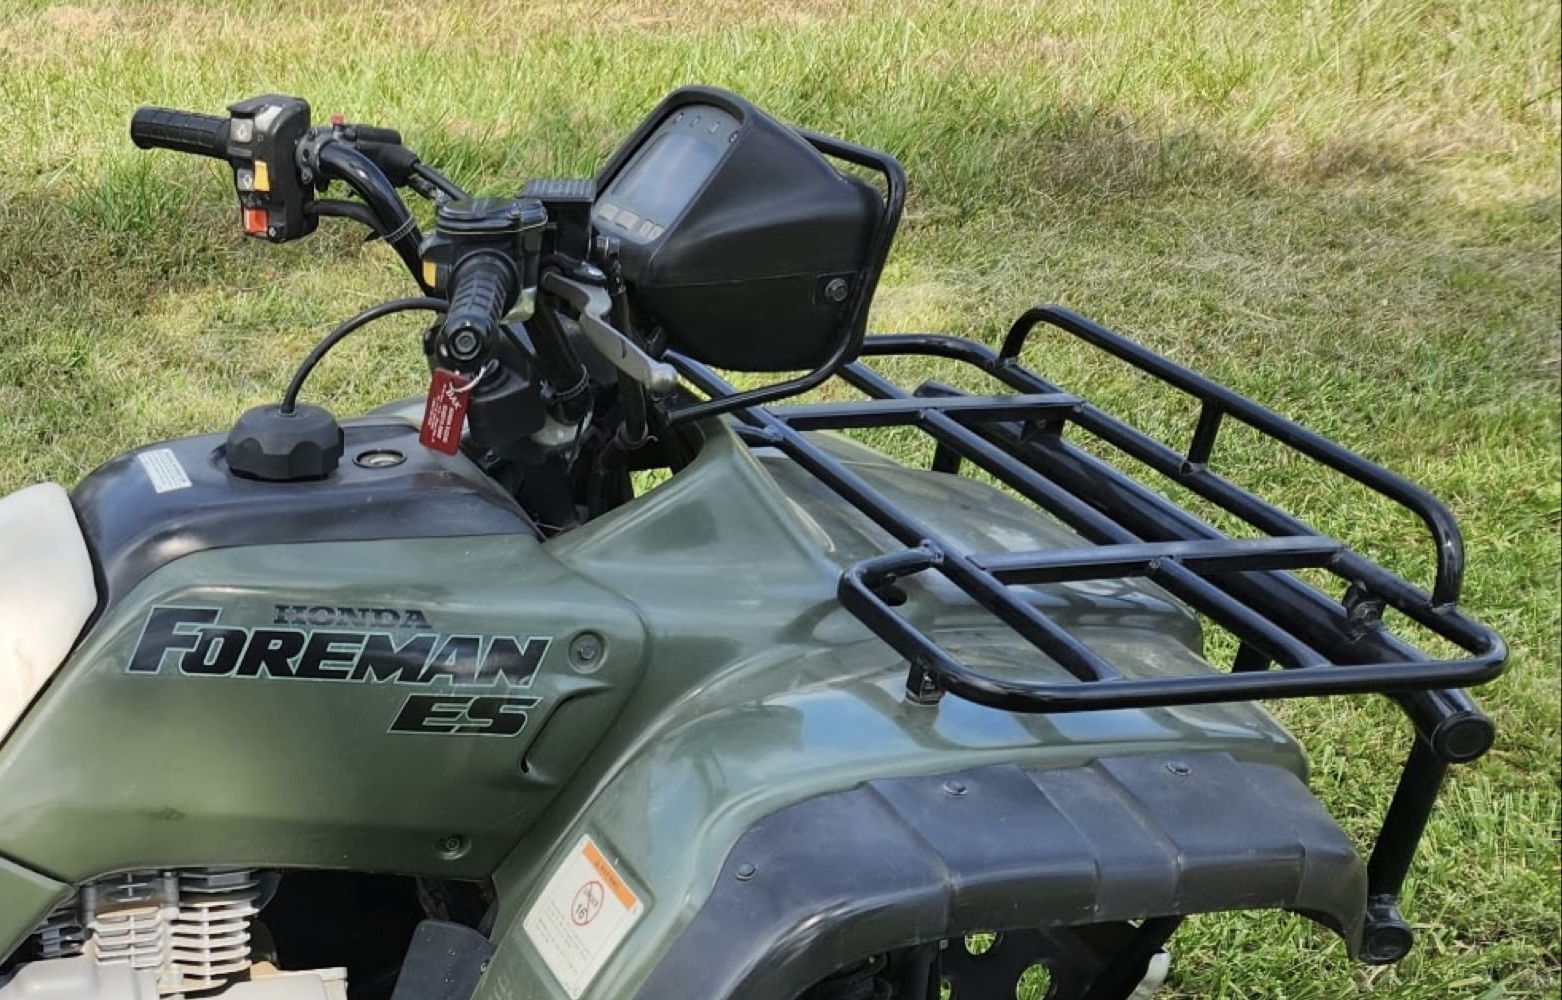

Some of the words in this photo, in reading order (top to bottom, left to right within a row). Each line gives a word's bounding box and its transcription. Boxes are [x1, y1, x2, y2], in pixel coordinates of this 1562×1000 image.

[273, 603, 433, 630] HONDA
[125, 605, 554, 689] FOREMAN
[386, 692, 542, 738] ES
